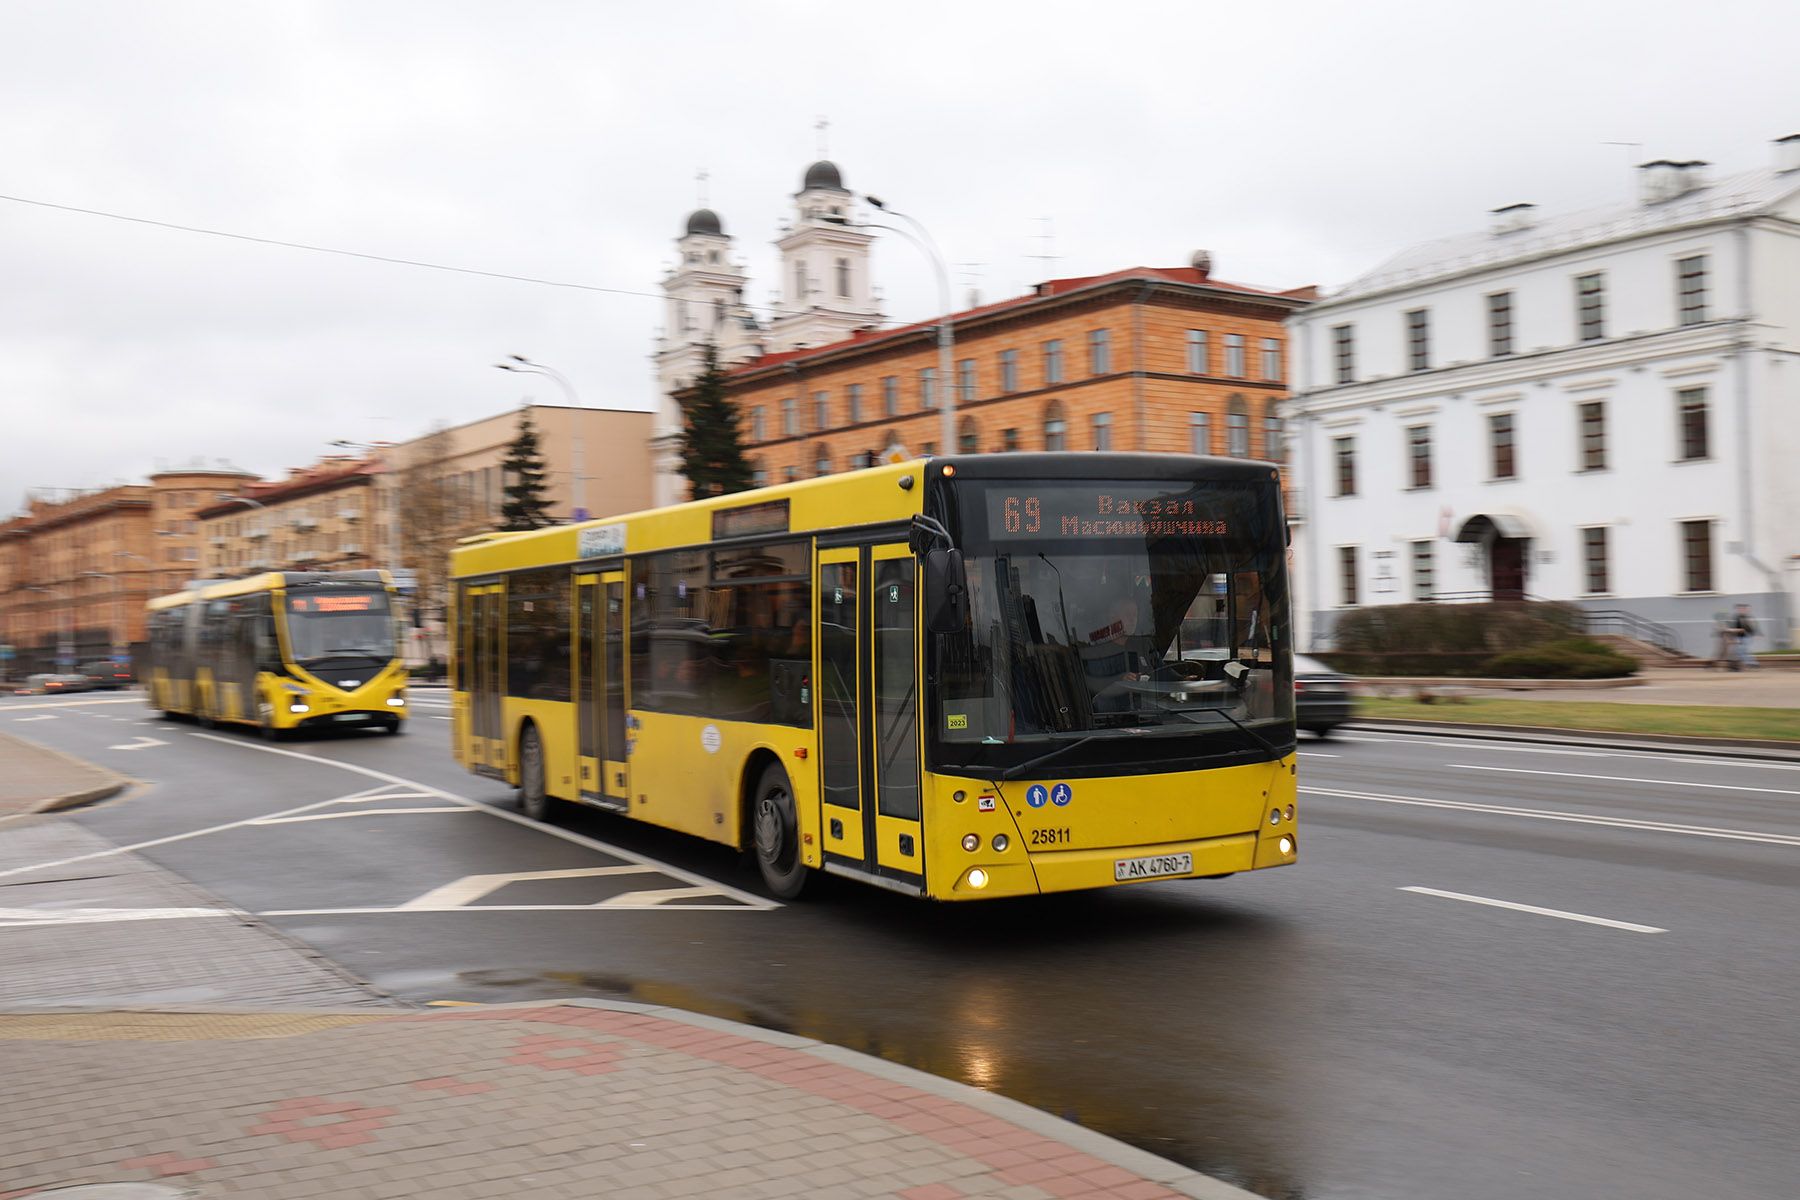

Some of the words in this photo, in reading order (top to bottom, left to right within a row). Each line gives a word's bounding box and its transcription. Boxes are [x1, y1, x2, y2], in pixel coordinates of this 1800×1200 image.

[1004, 497, 1041, 533] 69
[1098, 495, 1195, 515] Вакзал
[1032, 828, 1070, 844] 25811
[1128, 861, 1147, 876] AK
[1150, 855, 1190, 874] 4760-7
